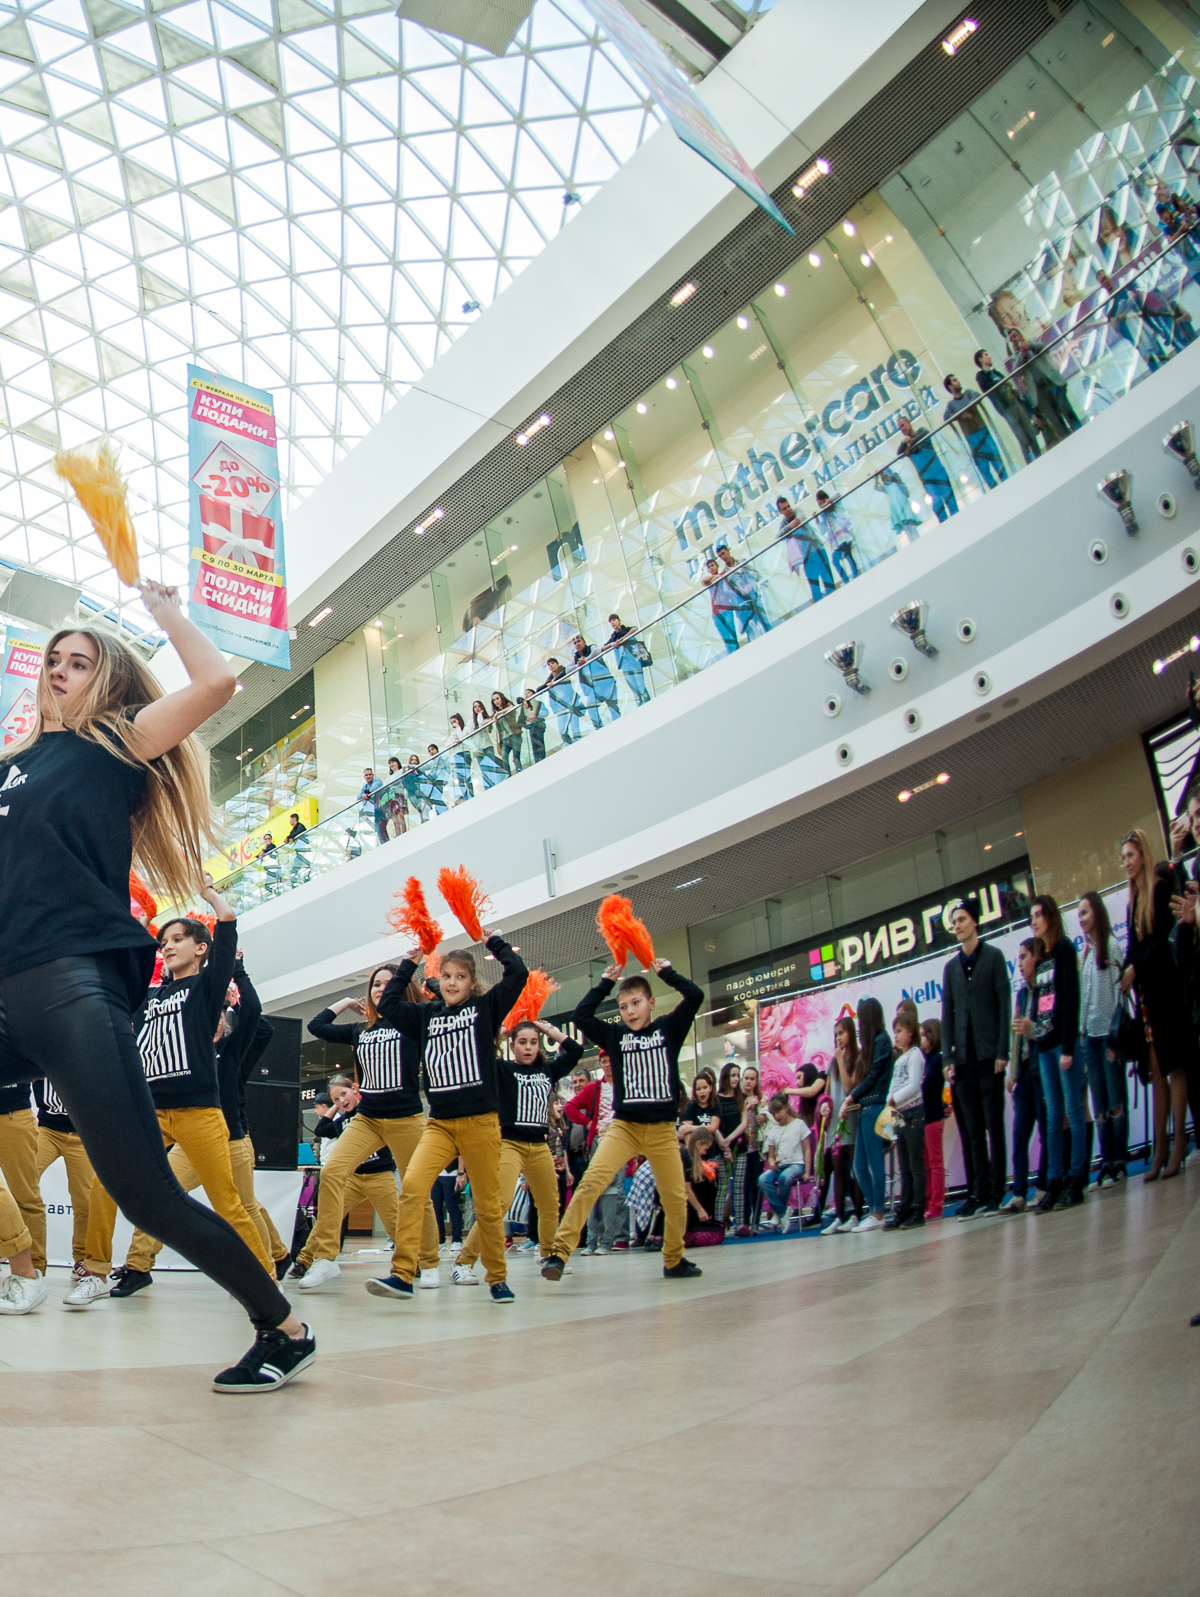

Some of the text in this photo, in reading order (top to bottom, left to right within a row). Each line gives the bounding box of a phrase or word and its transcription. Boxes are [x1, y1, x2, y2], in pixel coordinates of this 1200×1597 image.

[200, 395, 243, 418] КУПИ
[205, 385, 234, 399] ФЕВРАЛЯ
[251, 402, 270, 412] МАРТА
[789, 478, 812, 506] И
[812, 384, 940, 489] МАЛЫШЕЙ
[202, 474, 270, 500] -20%
[217, 559, 230, 568] ПО
[232, 564, 244, 572] 30
[246, 568, 274, 582] МАРТА
[204, 571, 274, 604] ПОЛУЧИ
[201, 586, 272, 619] СКИДКИ
[243, 634, 280, 650] moremall.ru
[842, 917, 917, 972] РИВ
[726, 963, 796, 991] парфюмерия
[733, 979, 790, 1002] косметика
[301, 1088, 316, 1100] FEE
